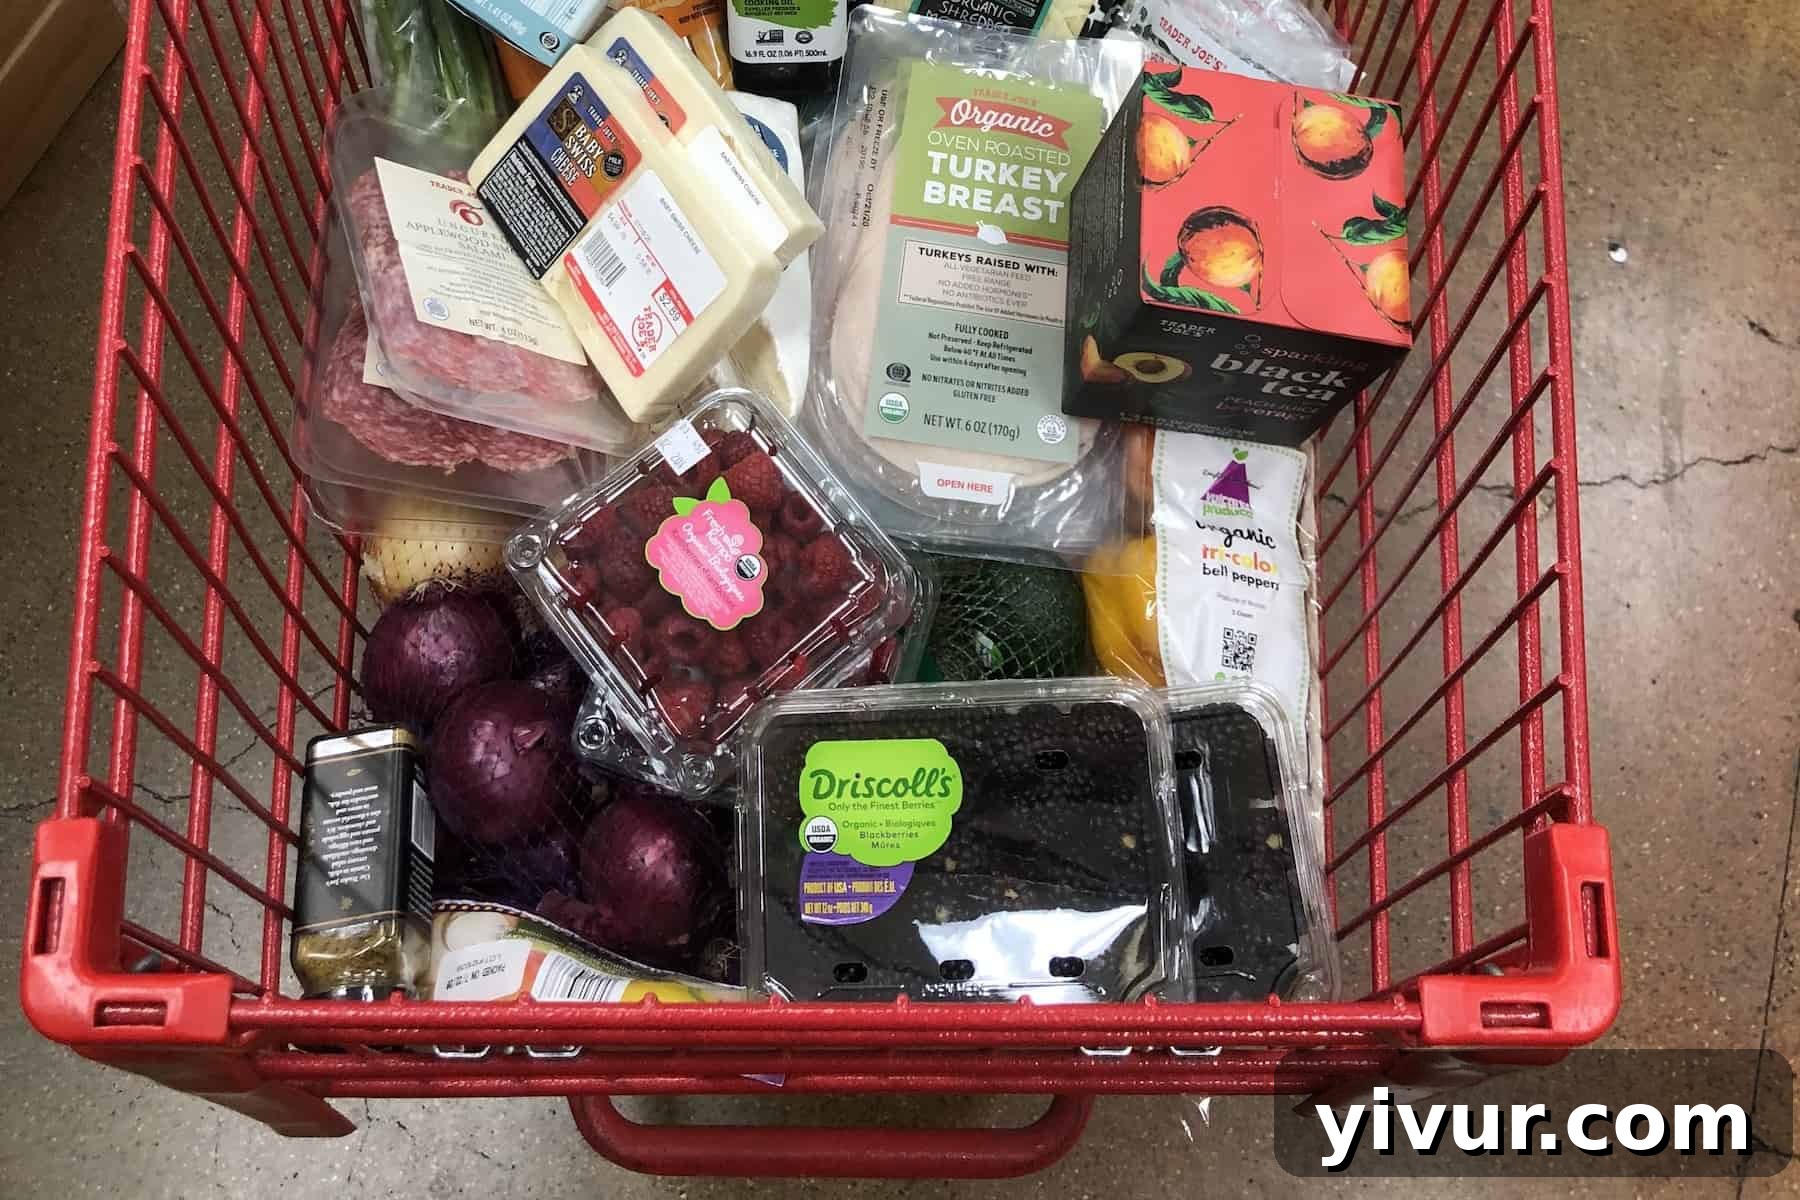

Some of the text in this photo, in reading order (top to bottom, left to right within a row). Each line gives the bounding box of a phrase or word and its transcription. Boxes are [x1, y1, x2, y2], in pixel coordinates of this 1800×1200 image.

[767, 49, 778, 58] OZ
[1160, 16, 1224, 72] TRADER JOE'S
[949, 99, 1056, 138] Organic
[575, 124, 604, 159] BABY
[927, 131, 1071, 167] OVEN ROASTED
[550, 147, 580, 187] CHEESE
[565, 135, 597, 178] SWISS
[927, 150, 1069, 194] TURKEY
[923, 179, 1065, 224] BREAST
[918, 246, 1059, 278] TURKEYS RAISED WITH:
[944, 262, 1032, 282] ALL VEGETARIAN FEED
[952, 281, 980, 293] ADDED
[643, 304, 657, 352] TRADER
[955, 323, 1009, 340] FULLY COOKED
[1159, 319, 1217, 335] TRADER
[1209, 353, 1352, 389] black
[921, 373, 932, 382] NO
[933, 375, 965, 387] NITRATES
[976, 381, 1006, 393] NITRITES
[1006, 386, 1029, 397] ADDED
[952, 389, 996, 403] GLUTEN FREE
[1261, 380, 1337, 401] tea
[923, 413, 1020, 441] NET WT. 6 OZ (170g)
[936, 477, 994, 494] OPEN HERE
[1202, 563, 1228, 577] bell
[809, 767, 953, 800] Driscoll's
[828, 801, 935, 812] Only the Finest Berries
[811, 824, 831, 834] USDA
[841, 818, 936, 830] Organic Biologiques
[859, 830, 919, 840] Blackberries
